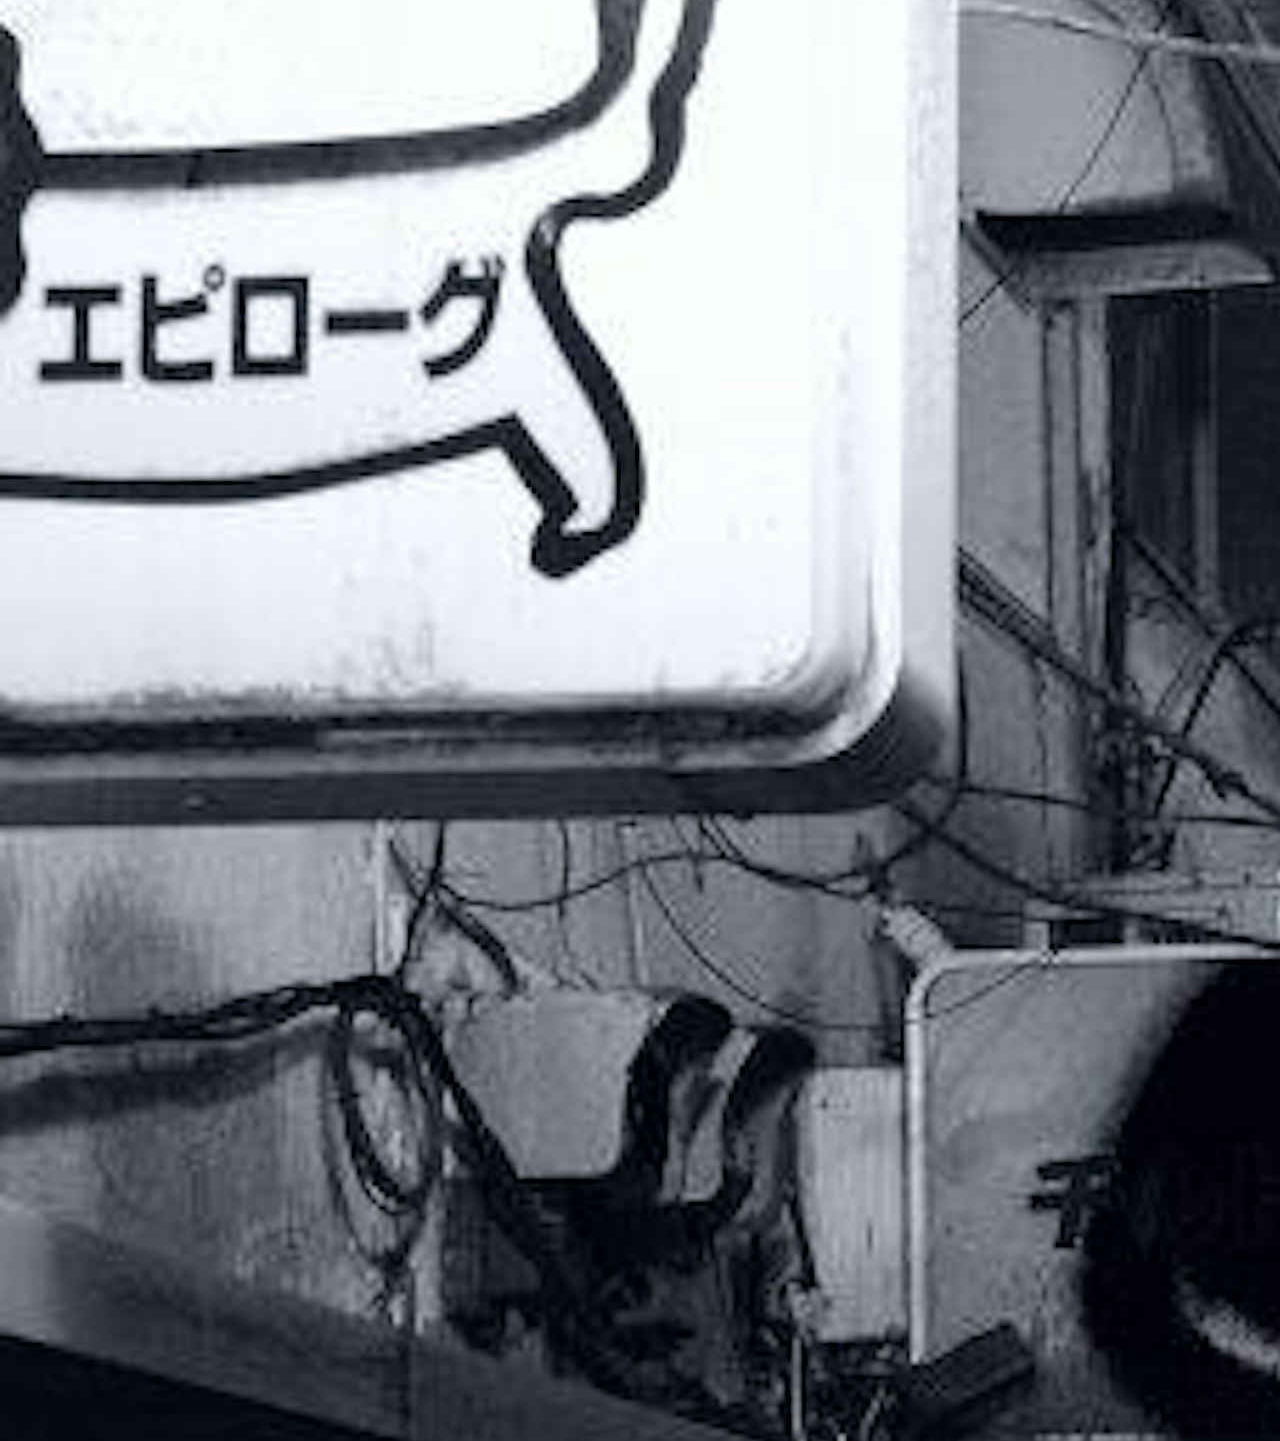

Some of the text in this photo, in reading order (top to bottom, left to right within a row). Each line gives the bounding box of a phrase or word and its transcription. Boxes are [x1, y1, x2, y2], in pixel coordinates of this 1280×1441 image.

[38, 256, 506, 384] エピローグ
